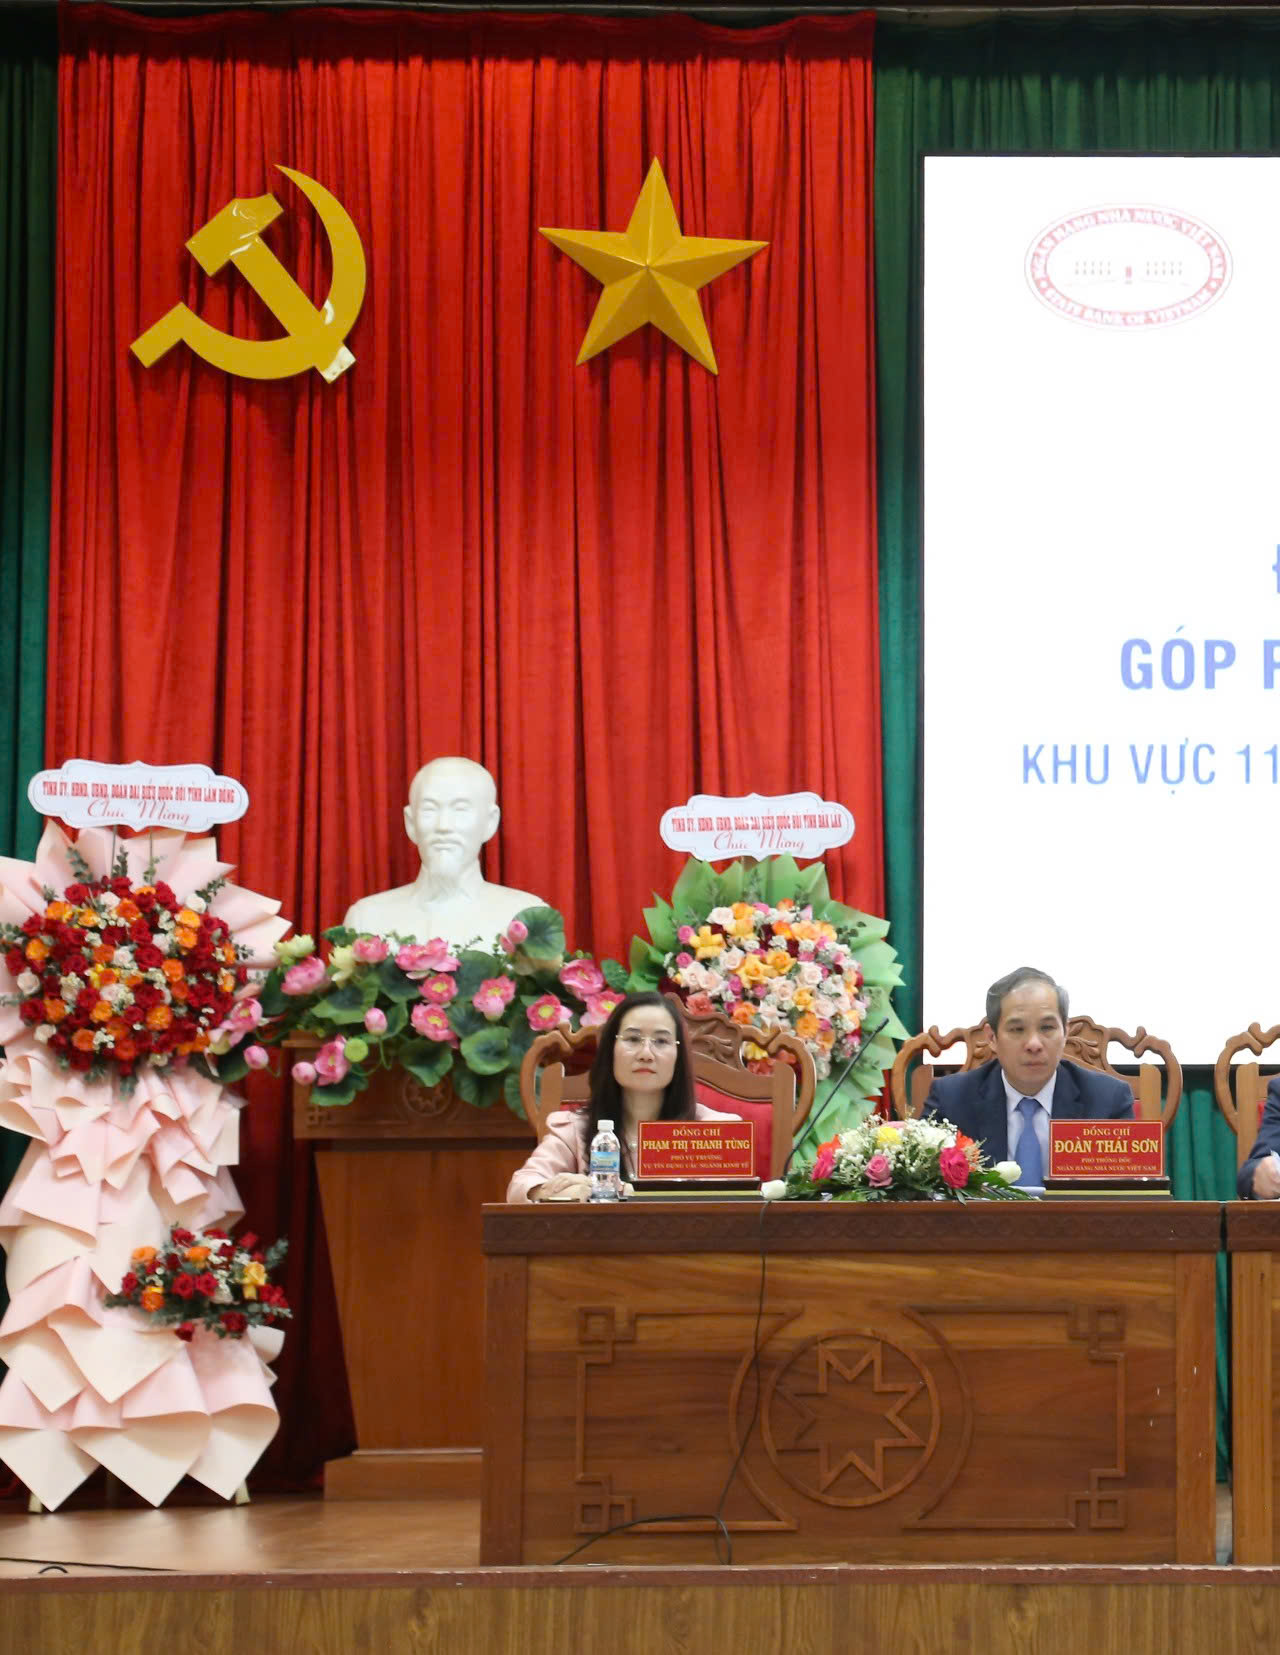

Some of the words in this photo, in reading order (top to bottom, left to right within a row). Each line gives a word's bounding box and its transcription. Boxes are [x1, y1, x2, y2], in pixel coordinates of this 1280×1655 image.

[1121, 626, 1235, 690] GÓP
[1023, 744, 1109, 784] KHU
[1130, 738, 1216, 793] VỰC
[1238, 744, 1278, 784] 11
[642, 1140, 670, 1152] PHẠM
[672, 1140, 688, 1153] THỊ
[690, 1140, 723, 1150] THANH
[725, 1137, 750, 1150] TÙNG
[1054, 1136, 1092, 1153] ĐOÀN
[1095, 1136, 1128, 1153] THÁI
[1131, 1138, 1159, 1153] SƠN
